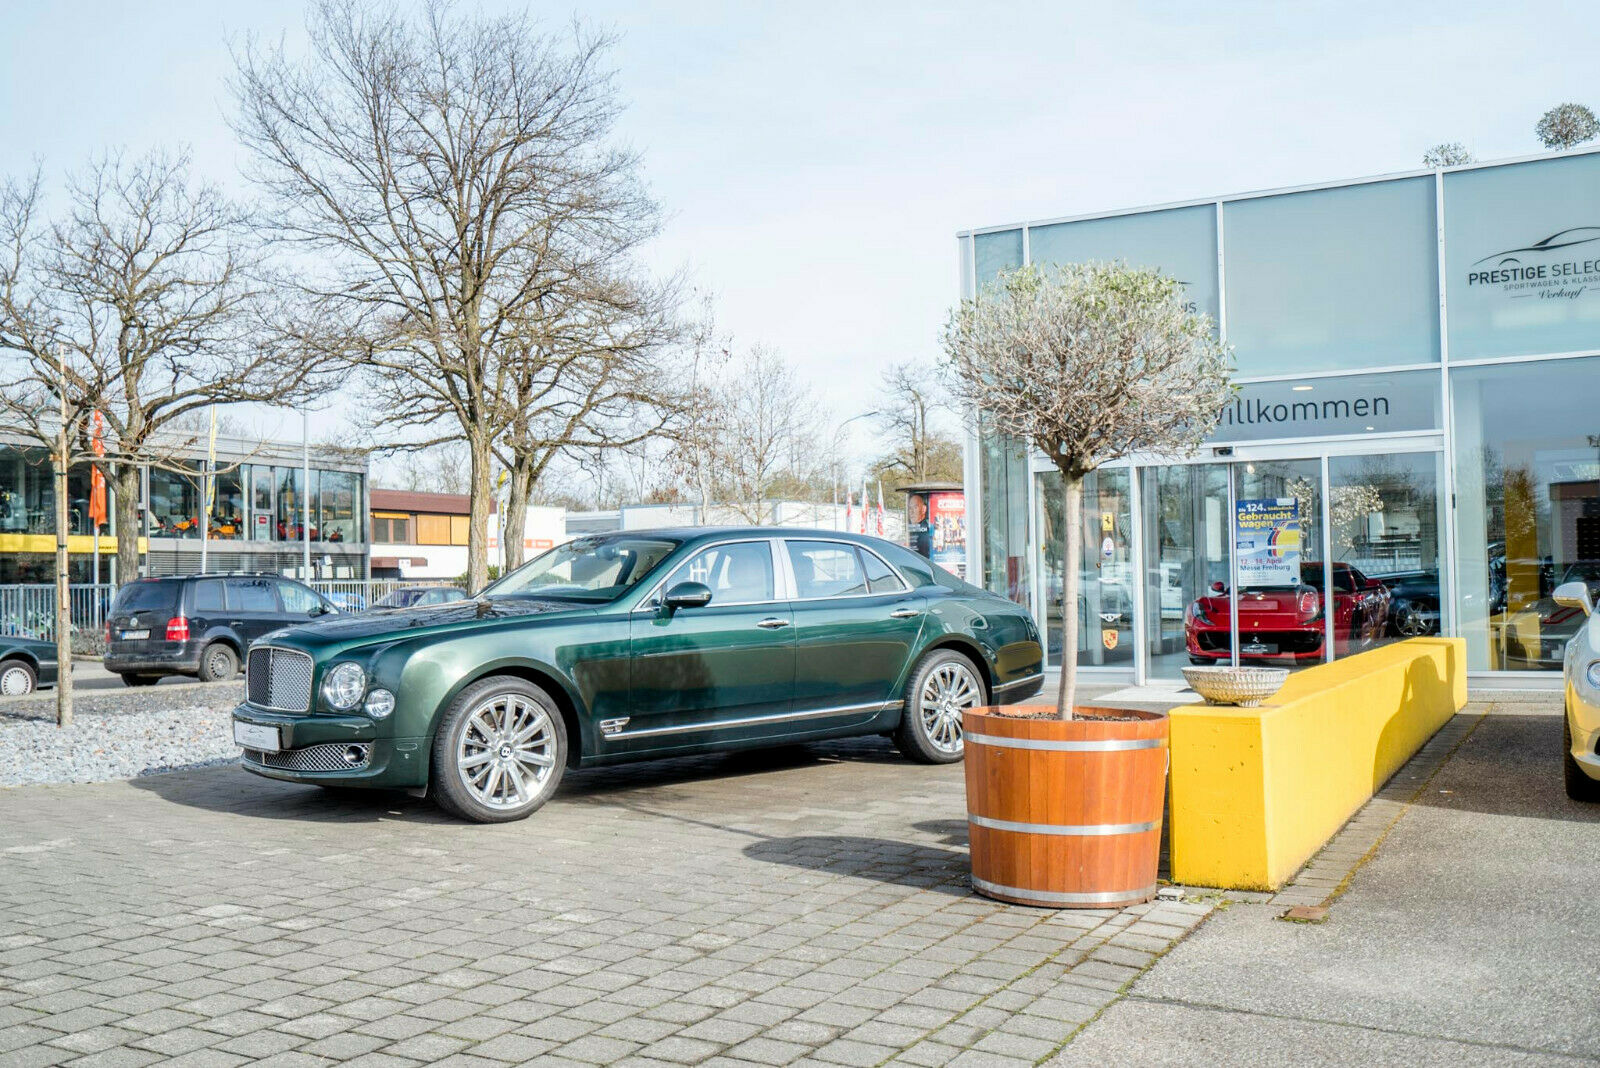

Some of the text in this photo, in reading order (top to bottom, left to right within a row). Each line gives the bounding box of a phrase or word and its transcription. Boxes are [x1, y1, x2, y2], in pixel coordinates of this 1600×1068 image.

[1468, 265, 1547, 286] PRESTIGE
[1503, 279, 1560, 291] SPORTWAGEN
[1539, 285, 1587, 299] Verkauf
[1246, 503, 1267, 512] 124.
[1238, 511, 1296, 521] Gebraucht-
[1239, 520, 1274, 529] wagen
